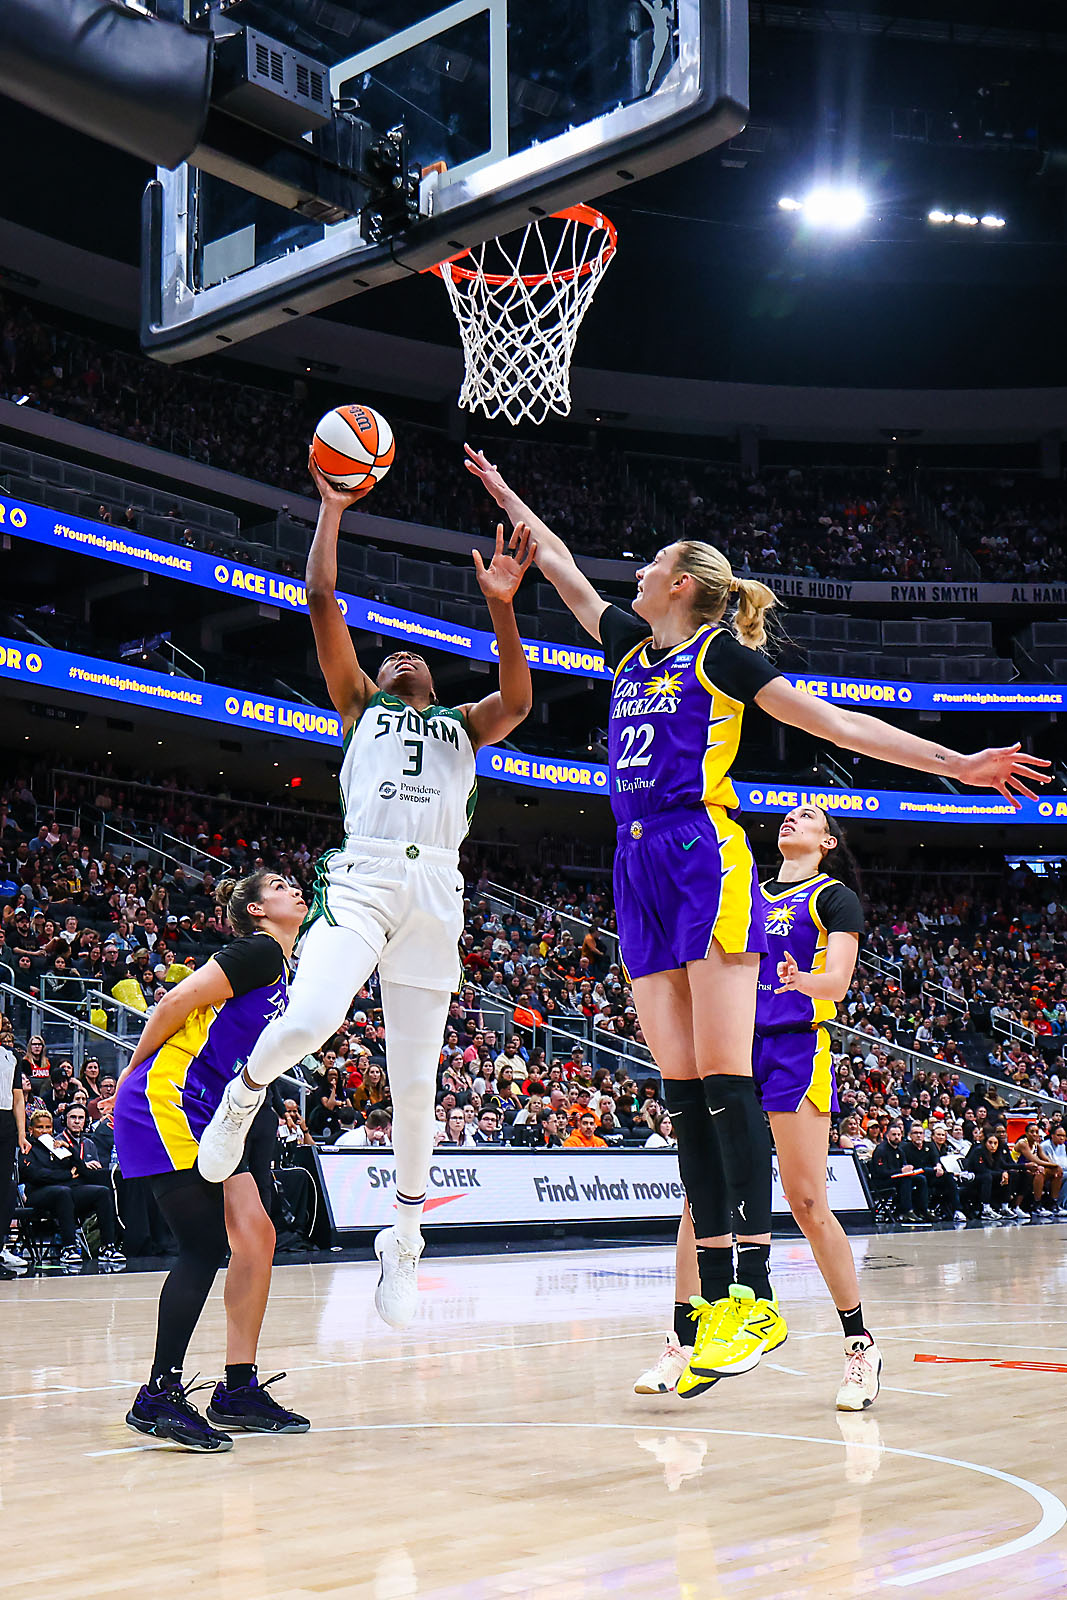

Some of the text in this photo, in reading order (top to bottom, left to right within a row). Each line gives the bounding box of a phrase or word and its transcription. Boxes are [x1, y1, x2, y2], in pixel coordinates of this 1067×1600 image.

[54, 523, 193, 572] #YourNeighbourhoodACE
[231, 569, 266, 595] ACE
[808, 582, 852, 600] HUDDY
[891, 586, 978, 602] RYAN SMYTH
[1011, 587, 1029, 602] AL
[542, 647, 605, 673] LIQUOR
[69, 666, 203, 705] #YourNeighbourhoodACE
[613, 678, 642, 699] LOS
[795, 680, 896, 702] ACE LIQUOR
[241, 700, 339, 737] ACE LIQUOR
[611, 695, 682, 720] ANGELES
[374, 709, 460, 752] STORM
[402, 739, 424, 777] 3
[616, 723, 656, 771] 22
[503, 757, 592, 785] ACE LIQUOR
[399, 793, 430, 804] SWEDISH
[400, 782, 441, 796] Providence
[765, 790, 799, 807] ACE
[429, 1165, 481, 1188] CHEK
[533, 1175, 579, 1203] Find
[580, 1175, 630, 1202] what
